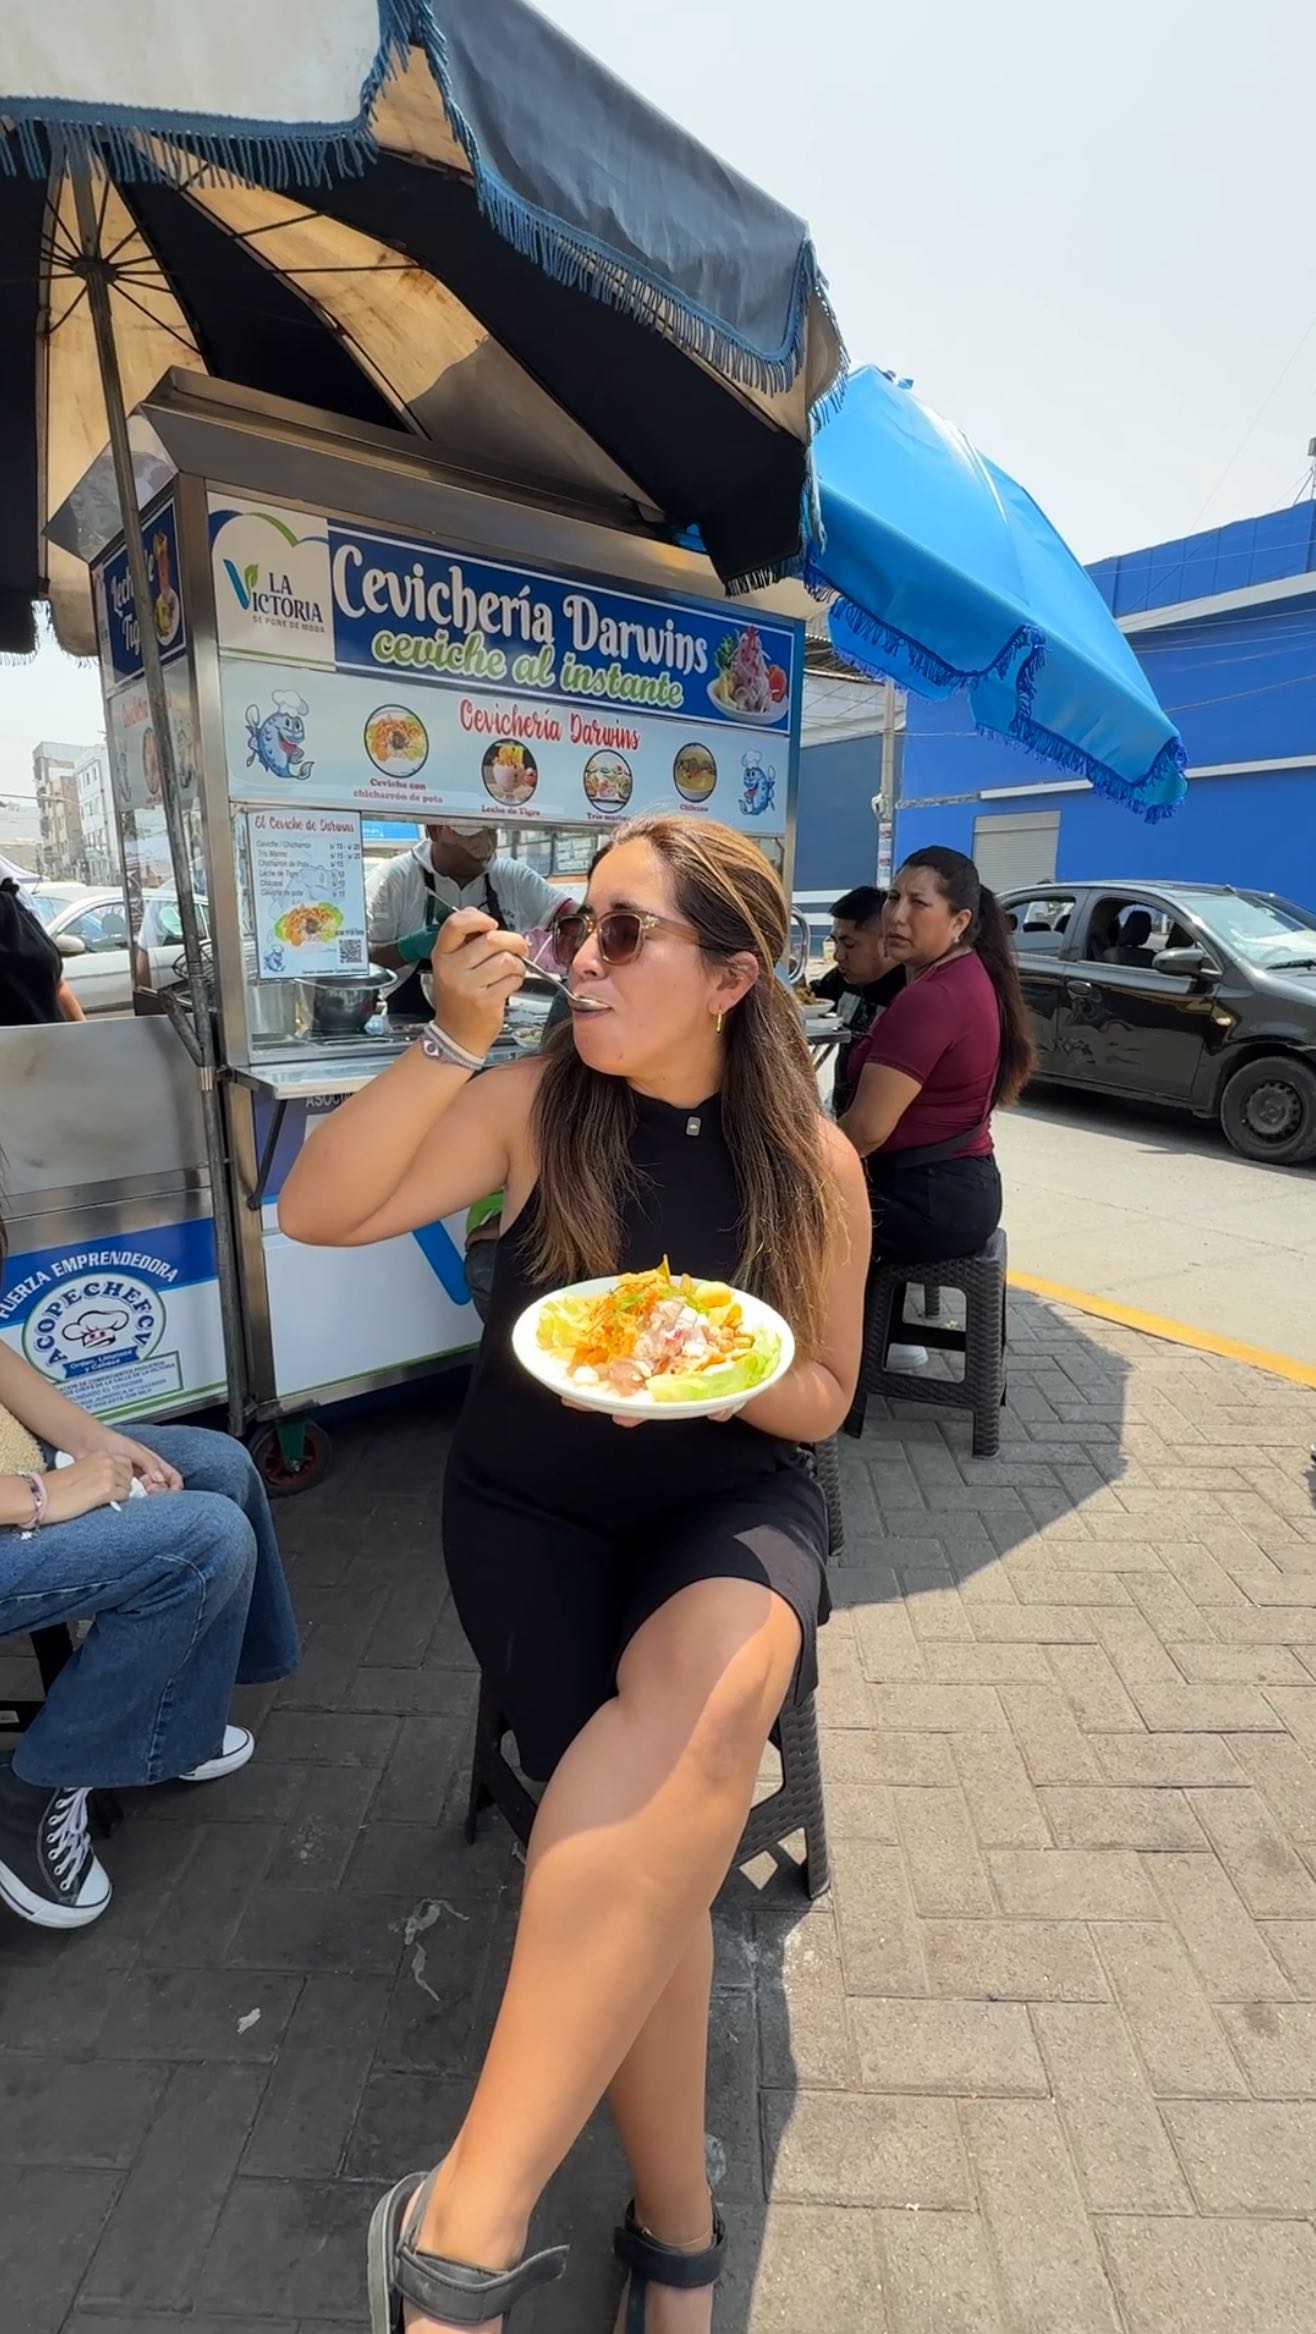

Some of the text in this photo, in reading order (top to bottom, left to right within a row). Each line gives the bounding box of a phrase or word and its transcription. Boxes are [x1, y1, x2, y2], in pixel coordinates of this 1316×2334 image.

[269, 572, 292, 595] LA
[333, 544, 708, 675] Cevichería Darwins
[372, 629, 684, 708] ceviche al instante
[460, 699, 640, 750] Cevichería Darwins
[370, 778, 426, 791] Ceviche con
[409, 793, 420, 801] de
[0, 1251, 178, 1319] FUERZA EMPRENDEDORA
